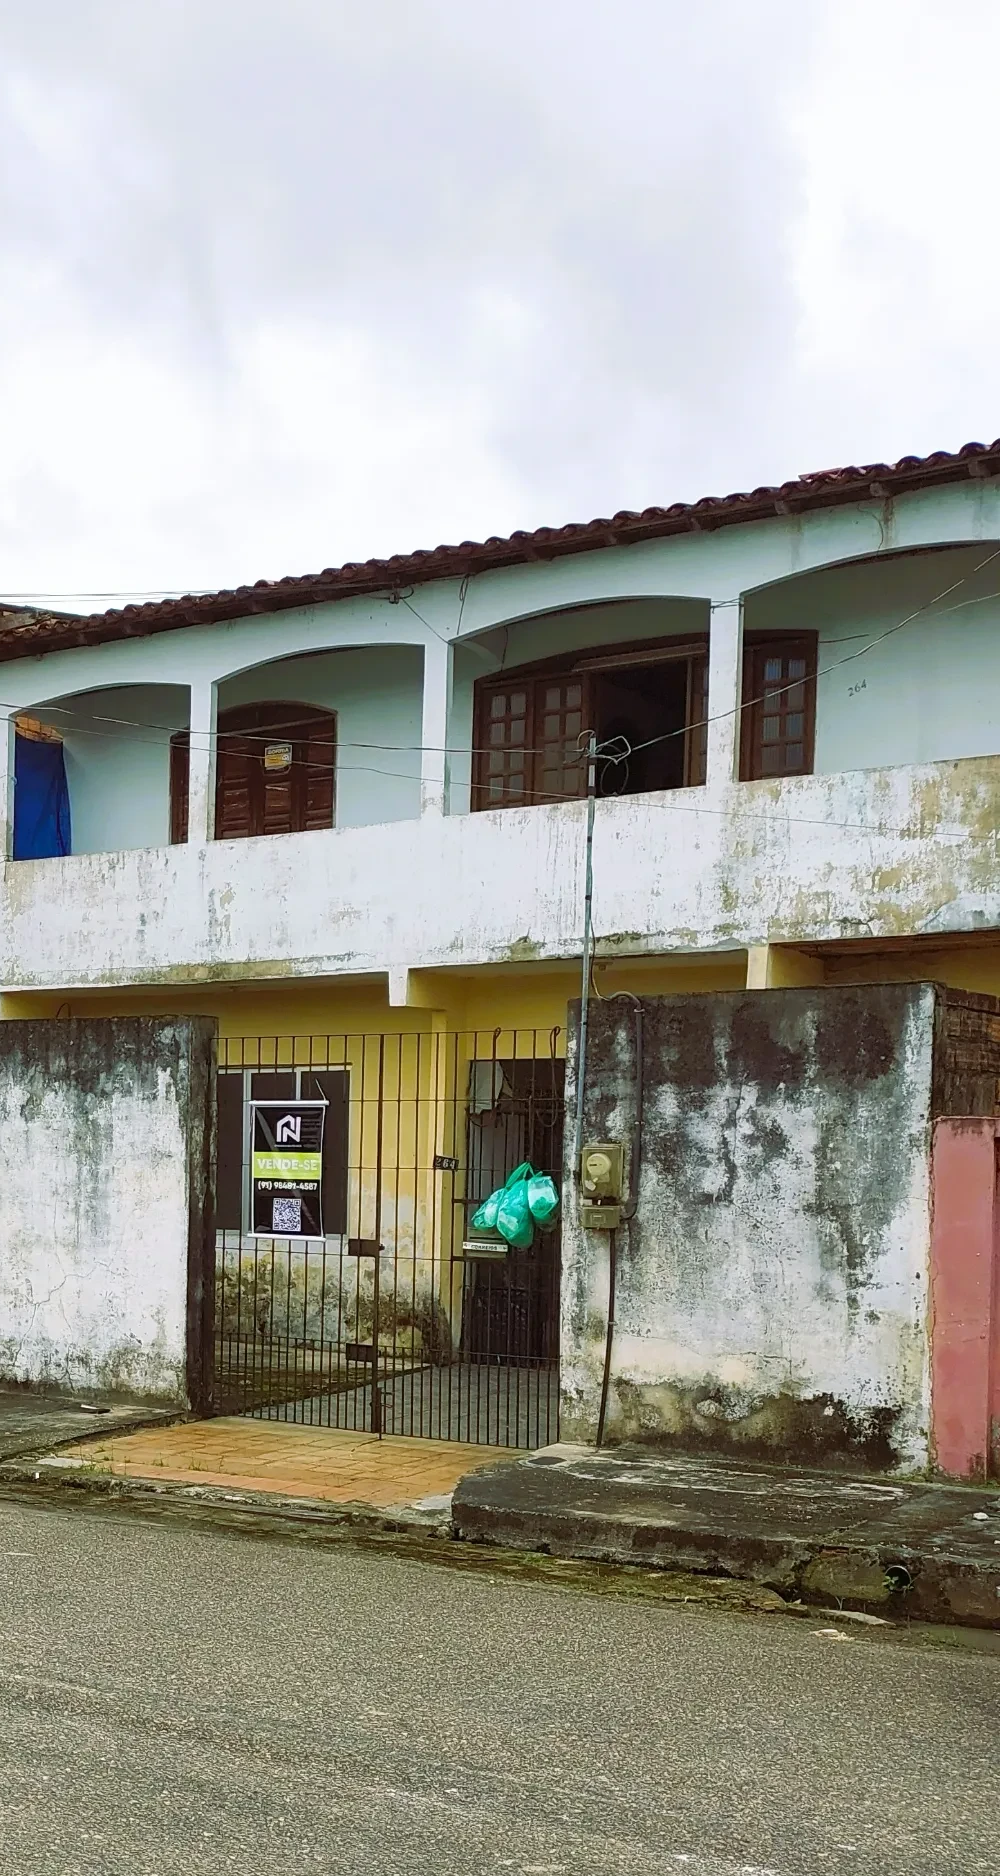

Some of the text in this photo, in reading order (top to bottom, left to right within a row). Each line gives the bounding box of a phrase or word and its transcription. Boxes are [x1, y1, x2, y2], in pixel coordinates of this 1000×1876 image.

[847, 679, 867, 697] 264
[257, 1158, 318, 1170] VENDE-SE
[436, 1157, 456, 1170] 264
[257, 1181, 272, 1190] (91)
